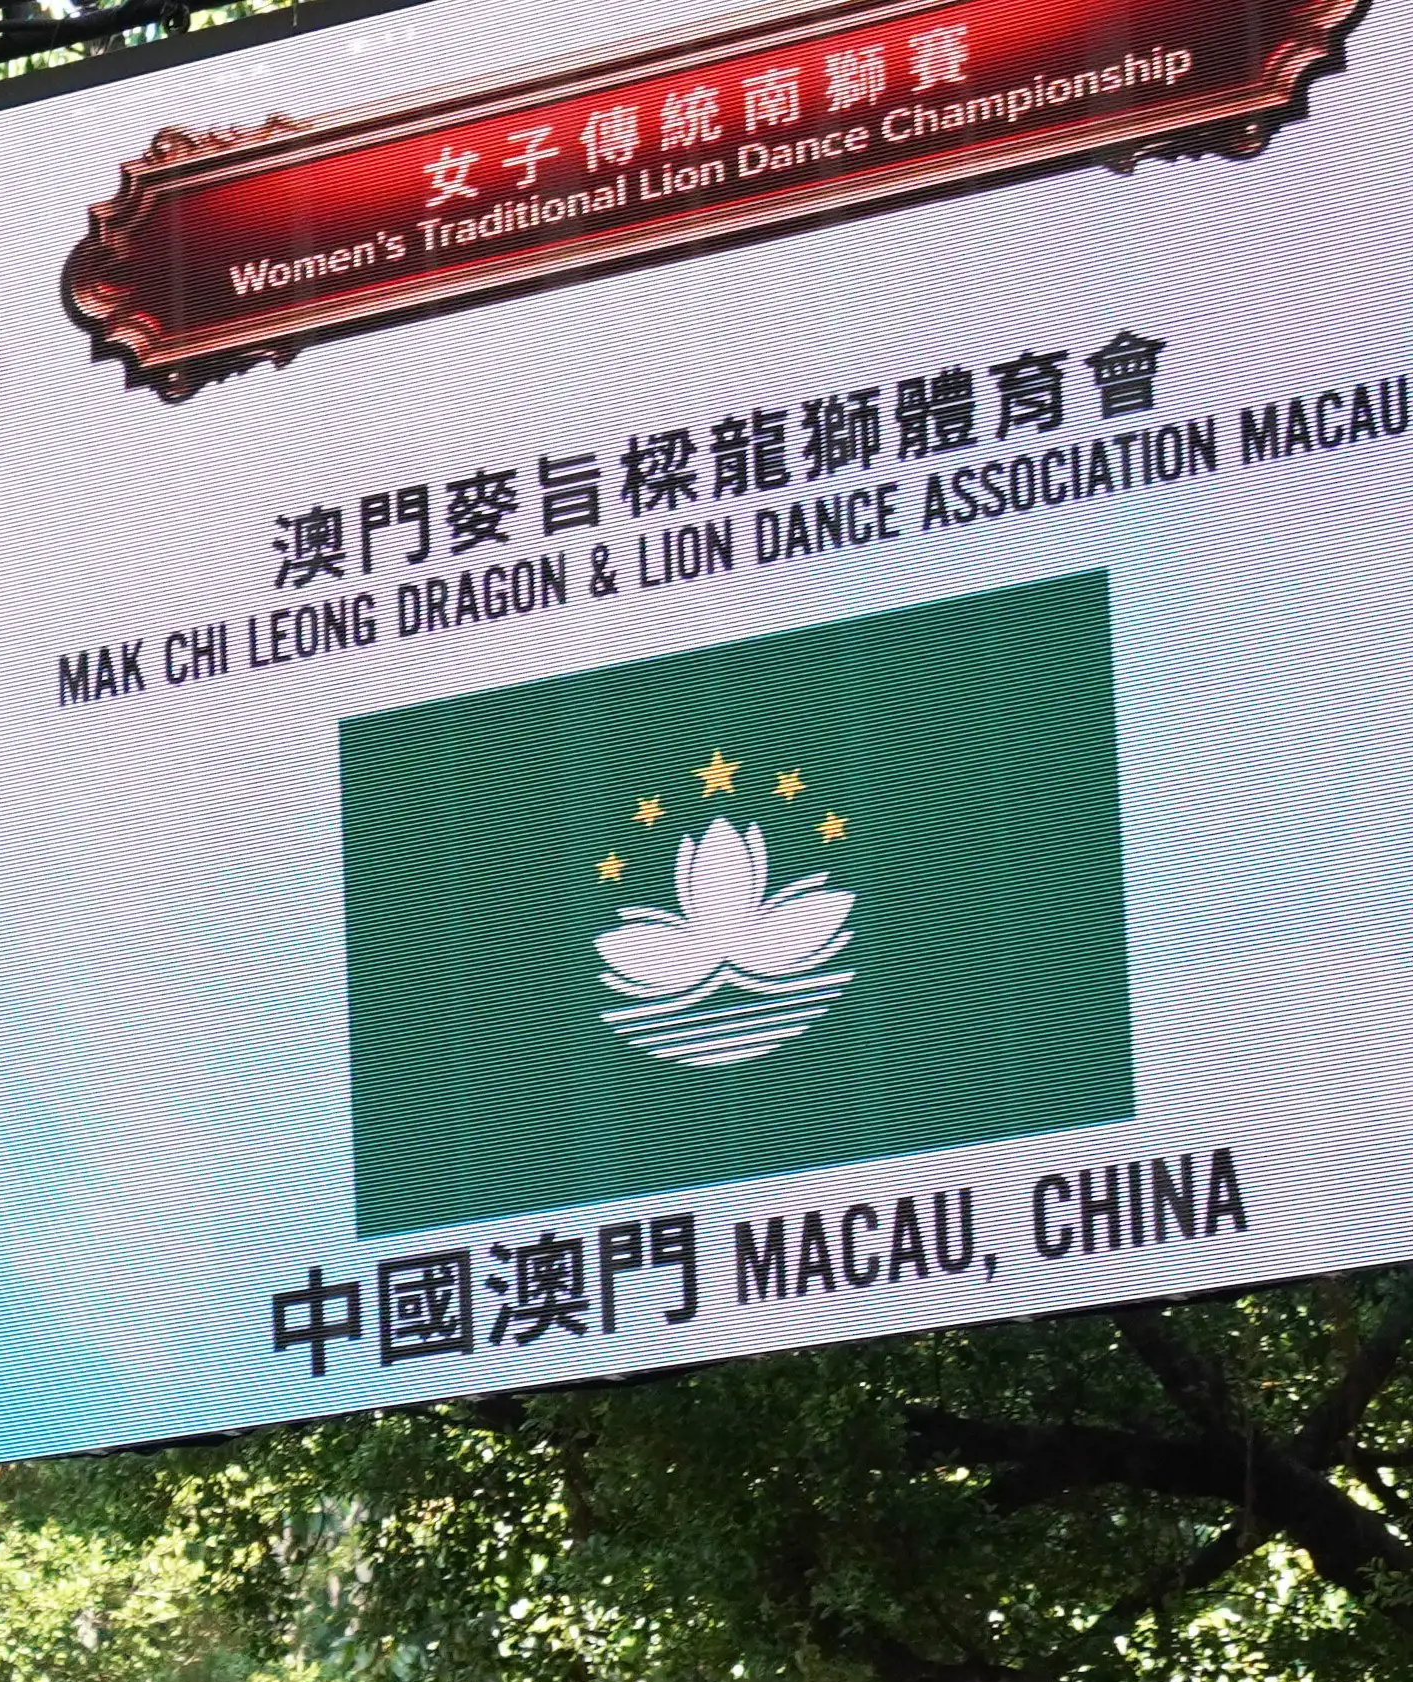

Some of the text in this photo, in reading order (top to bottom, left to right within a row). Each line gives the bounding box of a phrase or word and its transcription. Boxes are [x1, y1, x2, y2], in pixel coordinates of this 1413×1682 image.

[229, 45, 1194, 297] Women's Traditional Lion Dance Championship
[422, 23, 971, 208] 女子傳統南獅賽
[57, 372, 1409, 708] MAK CHI LEONG DRAGON & LION DANCE ASSOCIATION MACAU
[270, 1210, 699, 1378] 中國澳門
[732, 1145, 1249, 1306] MACAU, CHINA
